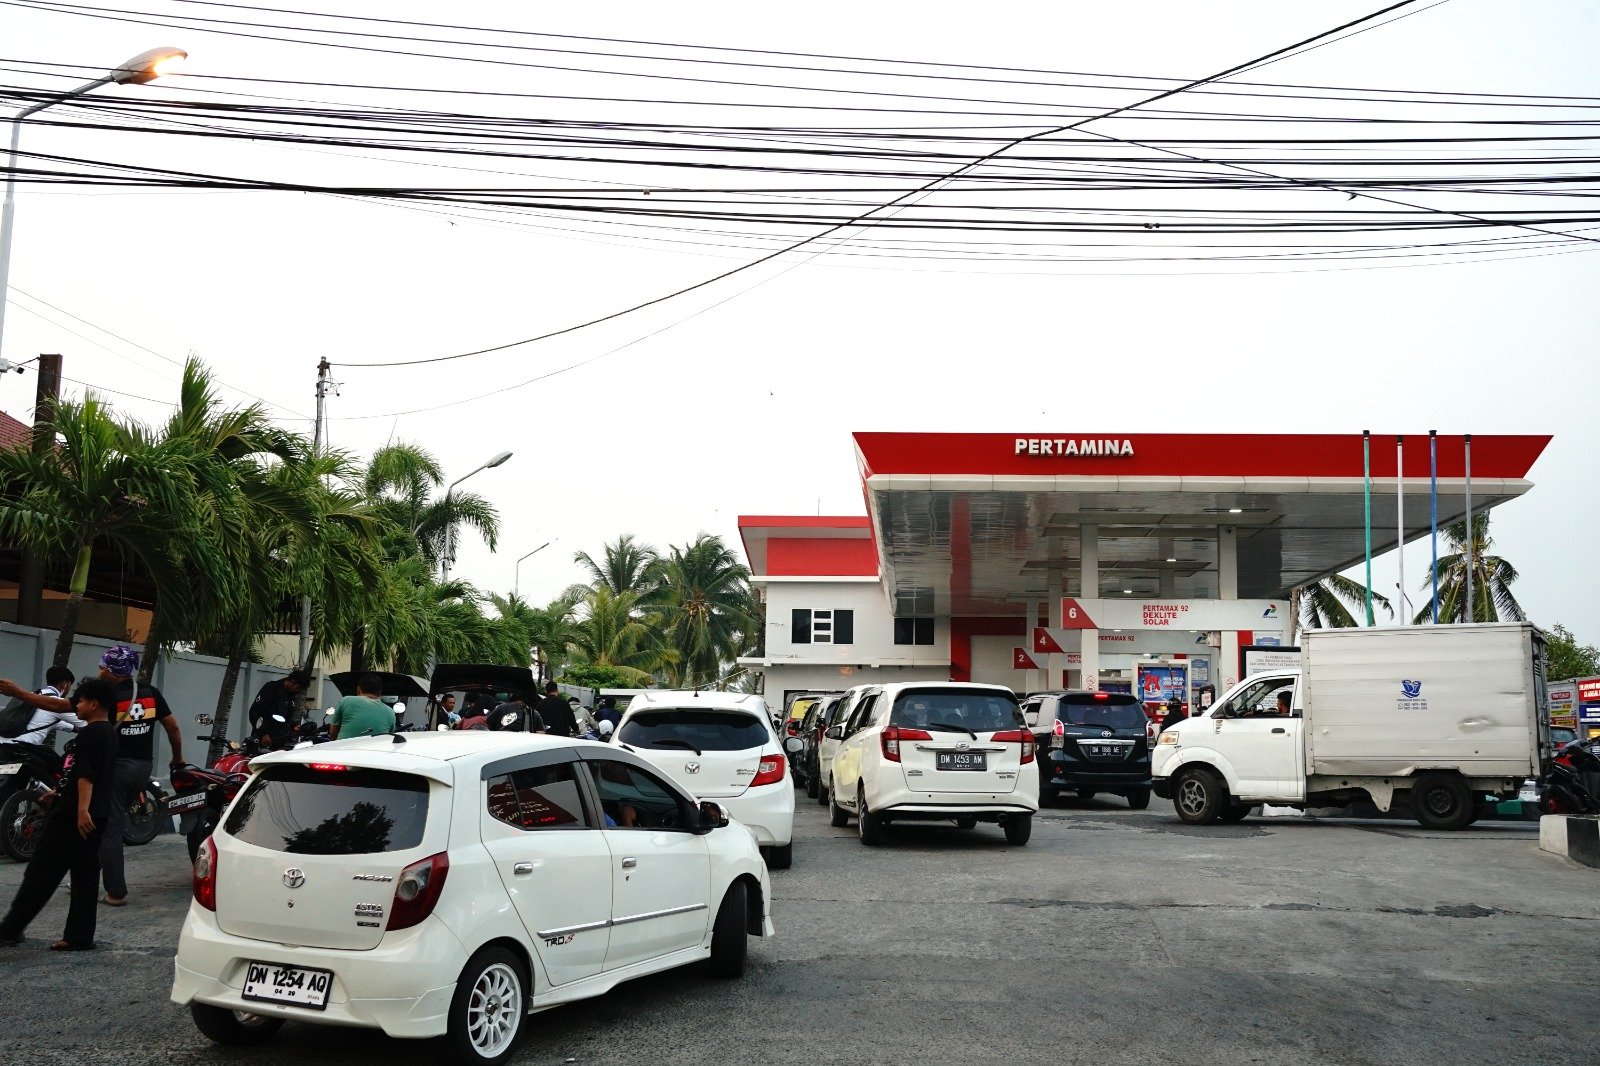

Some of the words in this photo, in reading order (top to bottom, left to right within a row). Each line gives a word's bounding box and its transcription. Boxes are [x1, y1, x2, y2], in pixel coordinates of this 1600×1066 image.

[1015, 438, 1134, 455] PERTAMINA
[1068, 607, 1077, 619] 6
[1039, 635, 1047, 646] 4
[1018, 654, 1025, 662] 2
[121, 725, 151, 736] GERMANY
[953, 754, 970, 764] 1453
[973, 755, 983, 764] AM
[355, 902, 382, 911] ASTRA
[249, 966, 269, 985] DN
[272, 969, 305, 989] 1254
[307, 974, 327, 993] AQ
